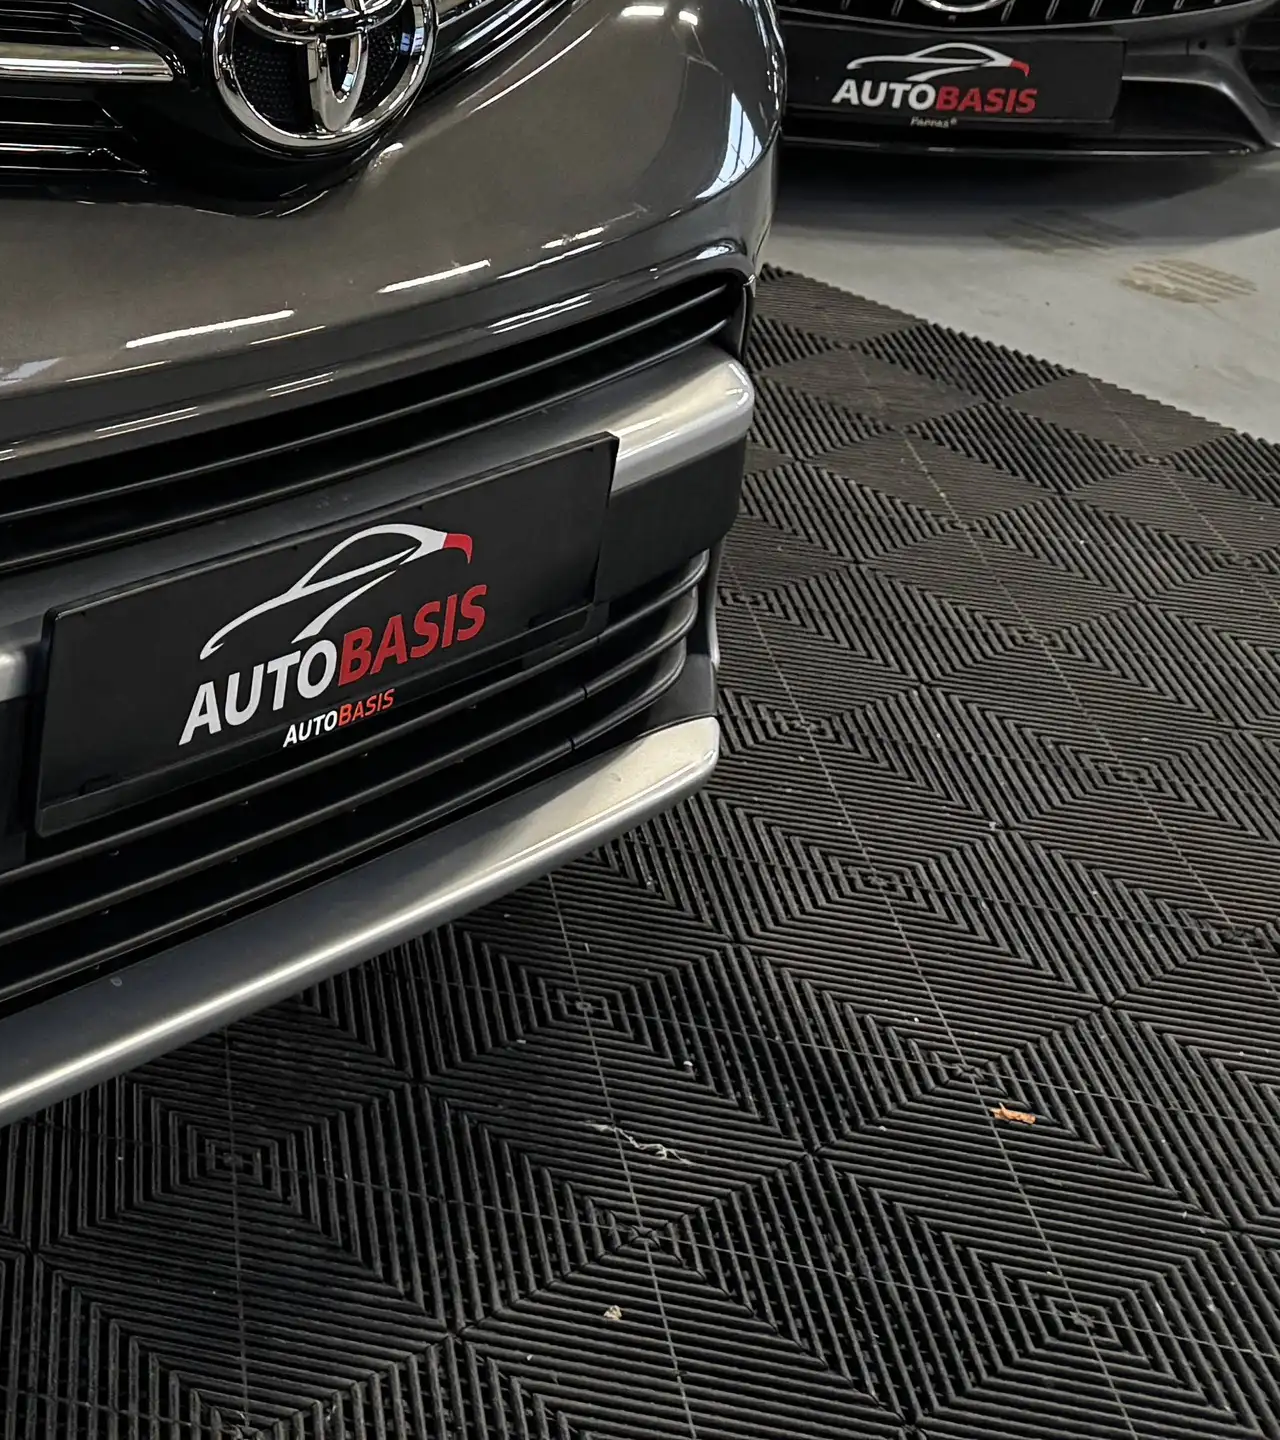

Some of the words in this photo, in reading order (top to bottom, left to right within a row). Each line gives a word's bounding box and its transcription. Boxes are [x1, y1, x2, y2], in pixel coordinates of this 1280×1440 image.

[831, 78, 1038, 114] AUTOBASIS
[178, 584, 487, 746] AUTOBASIS
[283, 688, 396, 748] AUTOBASIS
